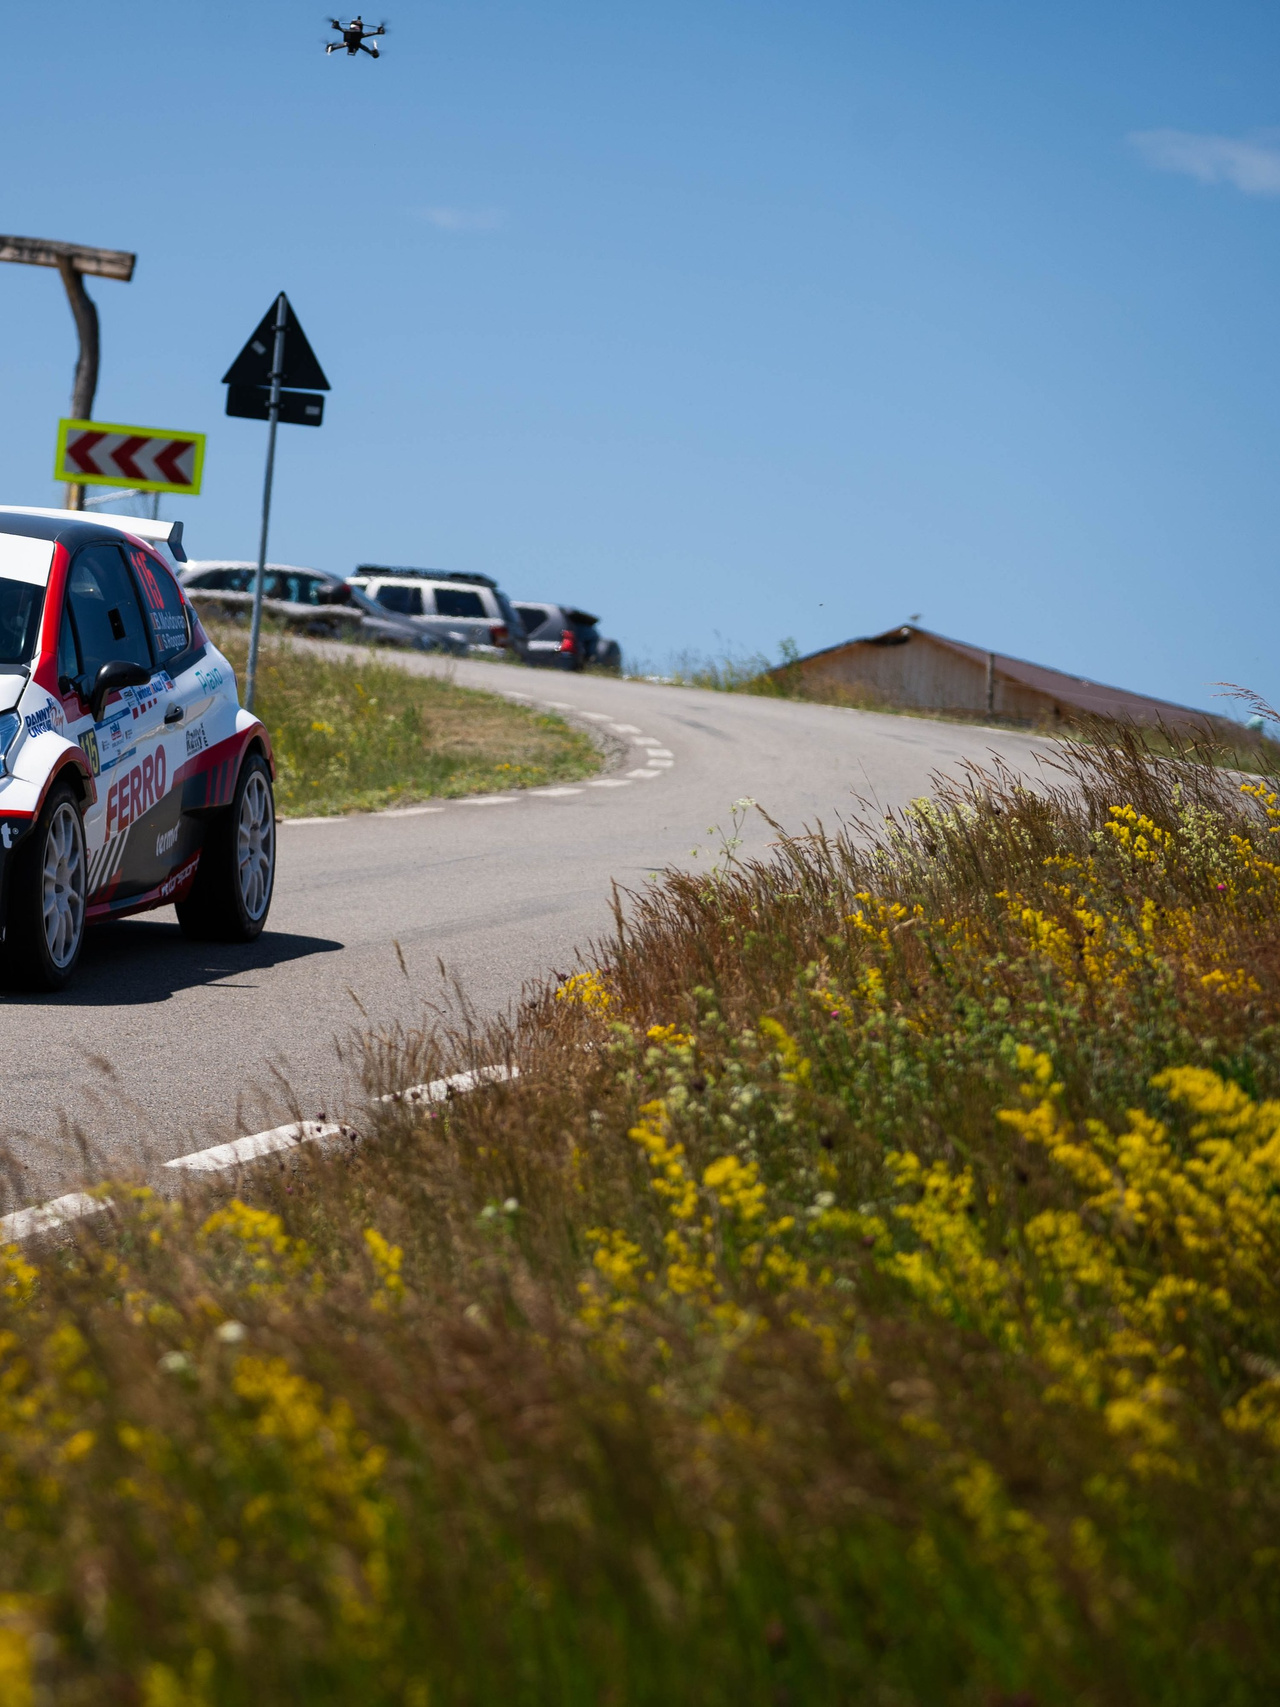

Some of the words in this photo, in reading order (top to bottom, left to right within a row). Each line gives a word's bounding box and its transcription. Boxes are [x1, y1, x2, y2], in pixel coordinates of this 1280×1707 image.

[130, 552, 165, 609] 115
[25, 706, 51, 728] DANNY
[105, 744, 166, 843] FERRO
